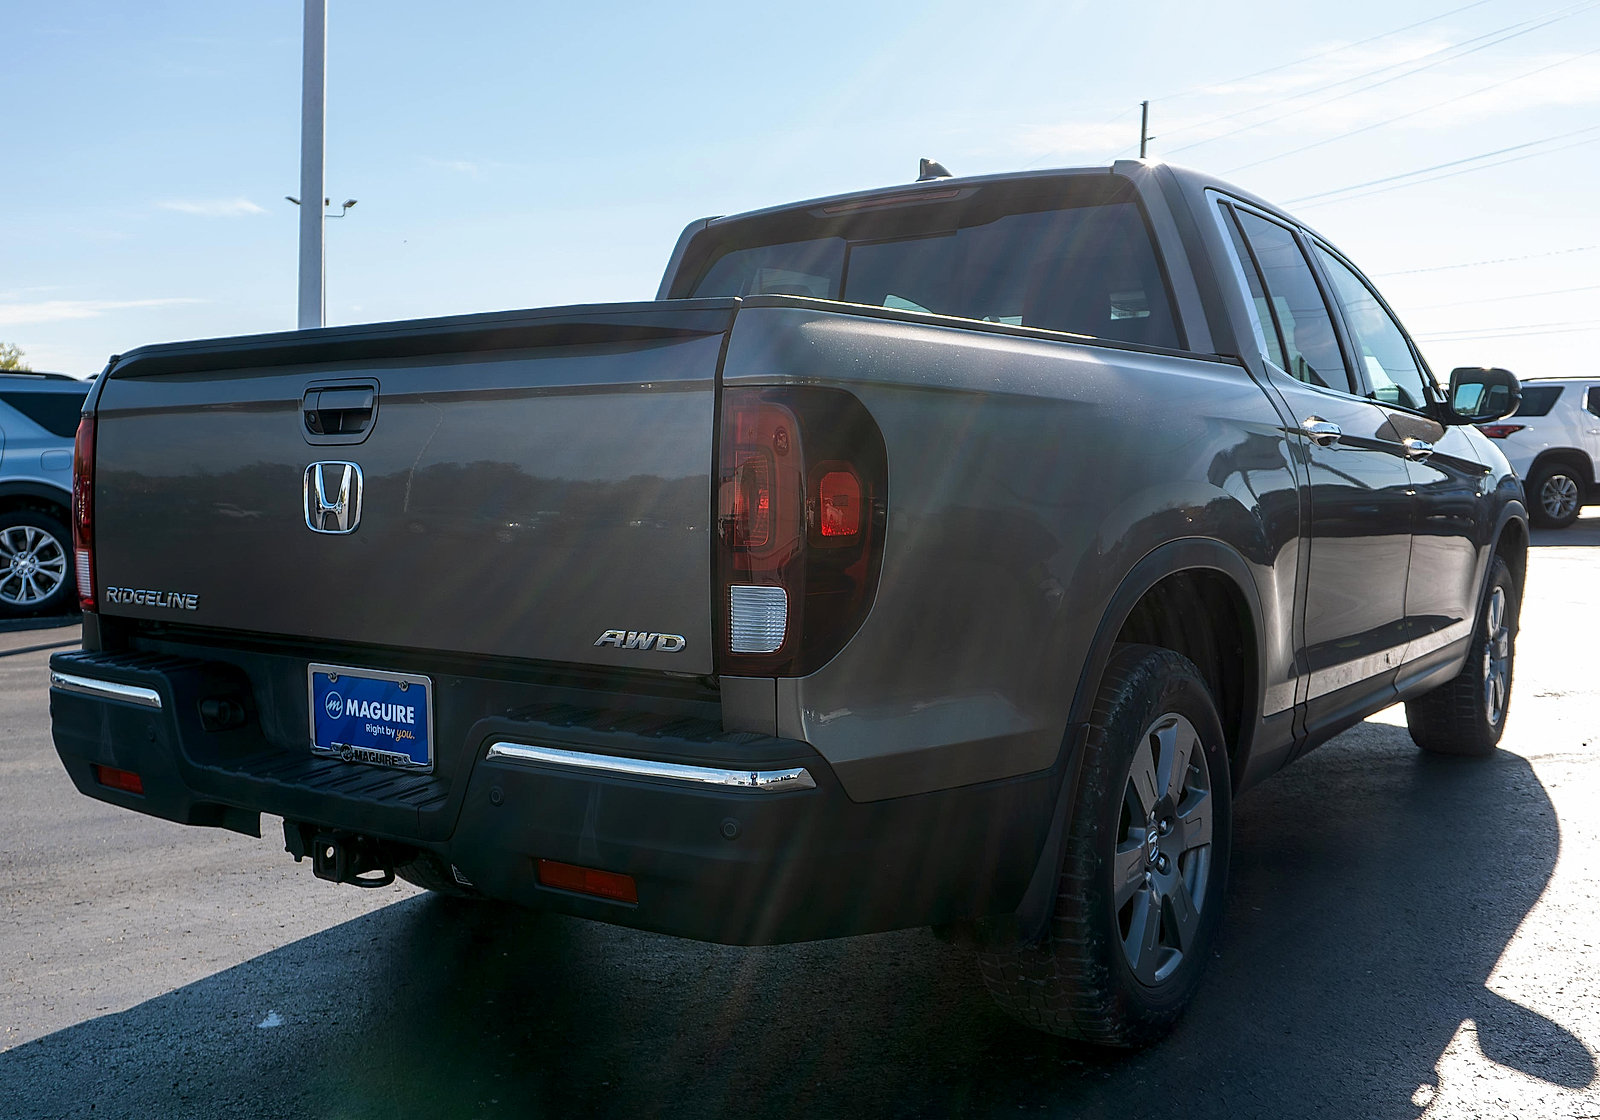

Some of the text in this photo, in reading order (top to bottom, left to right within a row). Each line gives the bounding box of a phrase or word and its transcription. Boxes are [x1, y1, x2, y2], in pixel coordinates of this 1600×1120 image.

[106, 586, 199, 610] RIDGELINE
[593, 629, 687, 653] AWD
[345, 698, 415, 724] MAGUIRE
[365, 723, 415, 742] Right by you.
[354, 750, 399, 766] MAGUIRE
